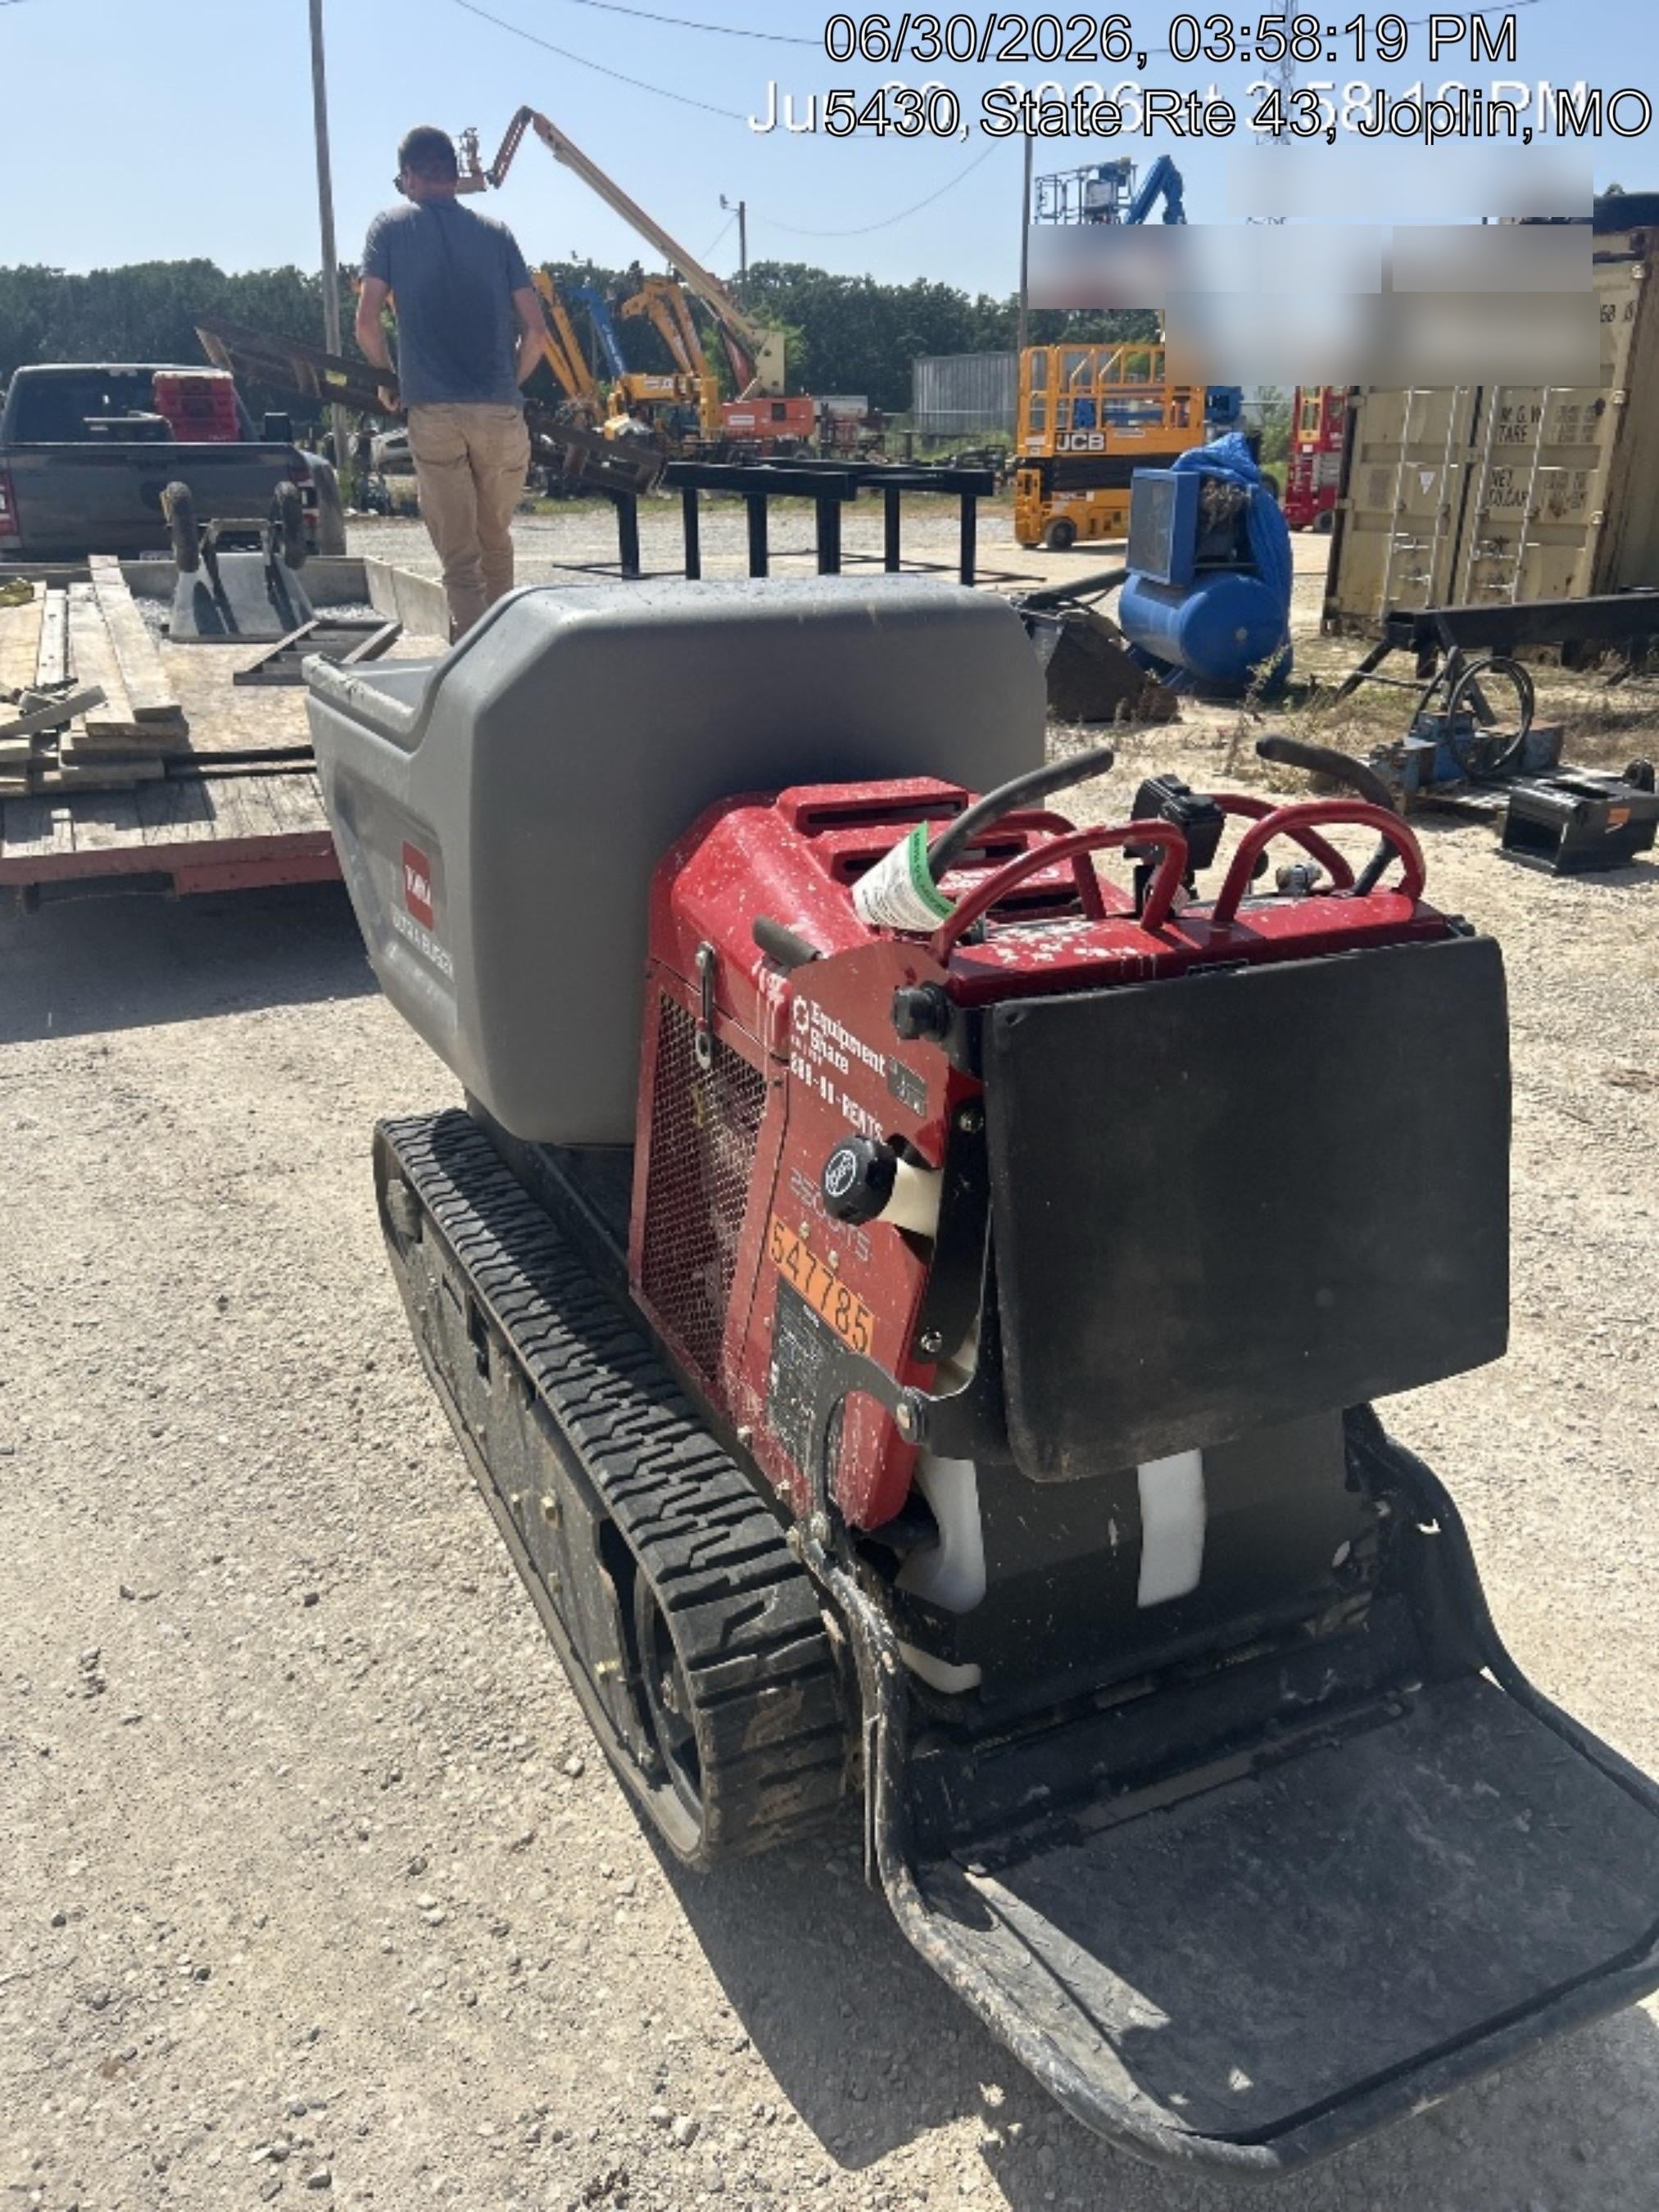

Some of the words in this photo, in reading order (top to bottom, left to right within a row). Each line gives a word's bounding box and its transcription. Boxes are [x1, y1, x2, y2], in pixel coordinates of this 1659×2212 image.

[1055, 433, 1105, 451] JCB
[809, 1027, 850, 1076] Share
[810, 999, 886, 1078] Equipment
[771, 1221, 869, 1353] 547785
